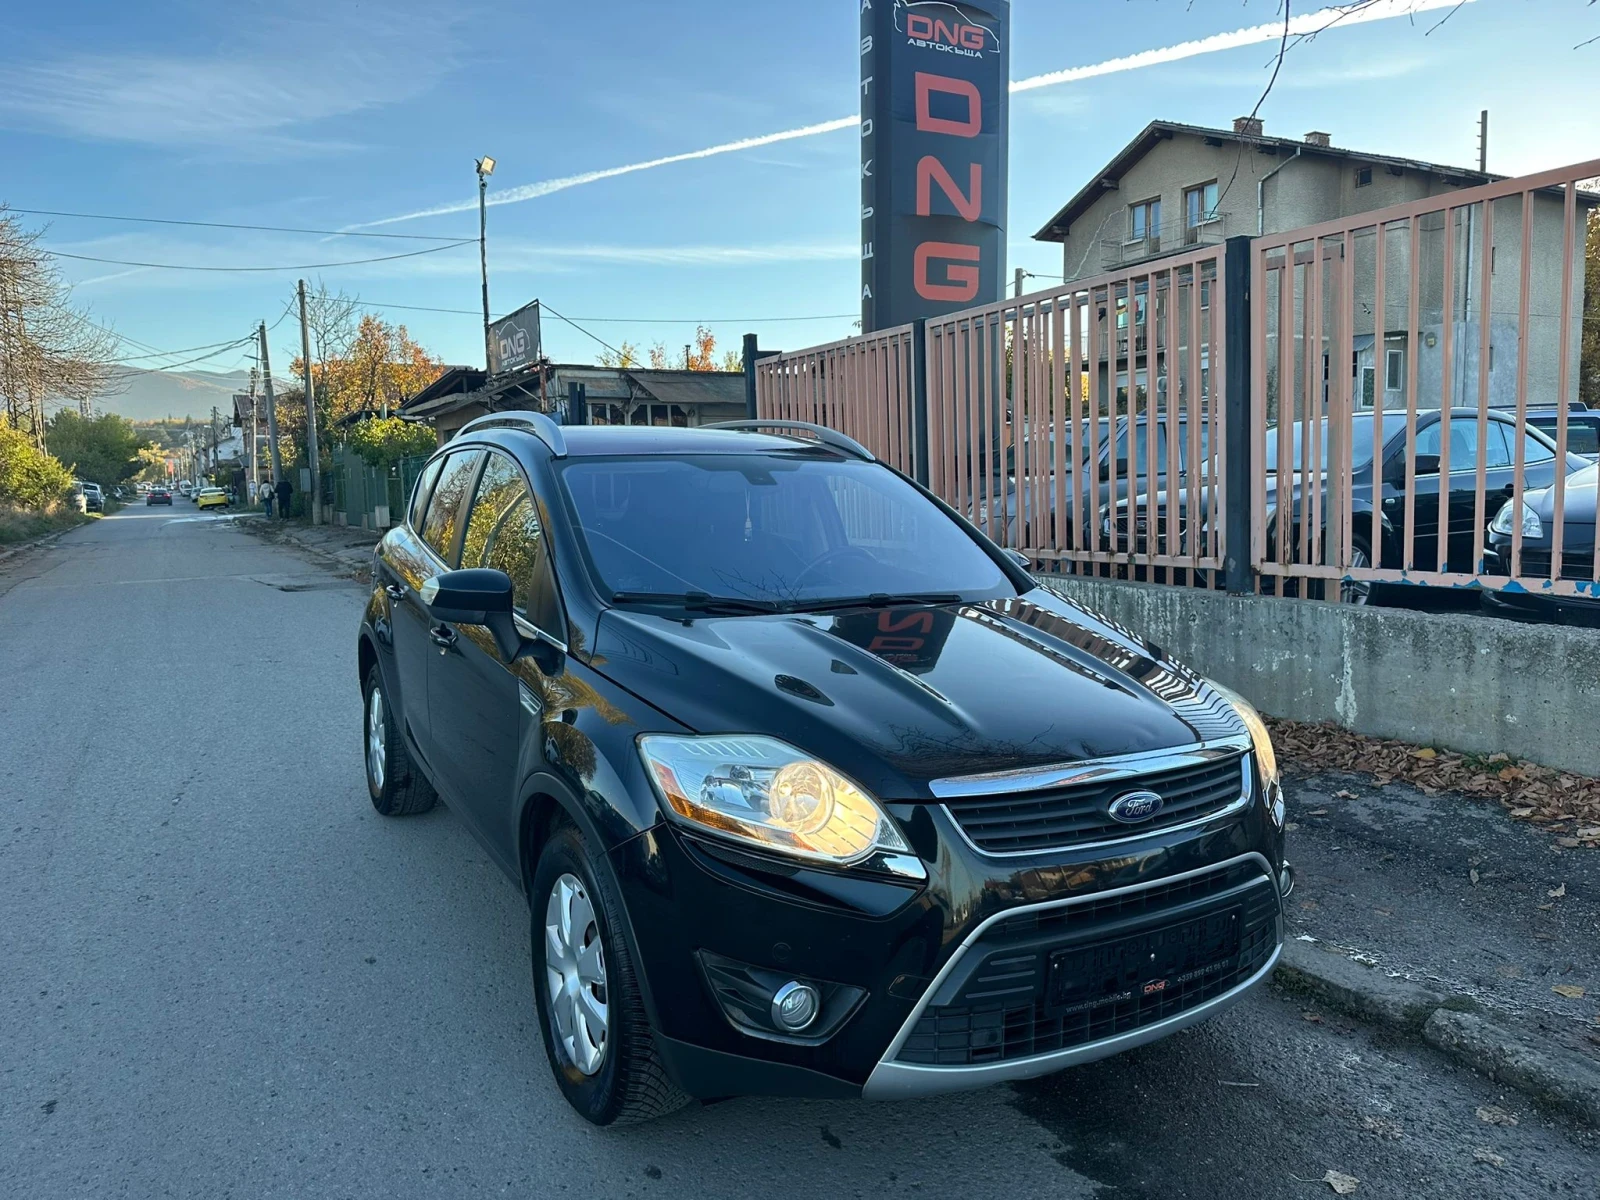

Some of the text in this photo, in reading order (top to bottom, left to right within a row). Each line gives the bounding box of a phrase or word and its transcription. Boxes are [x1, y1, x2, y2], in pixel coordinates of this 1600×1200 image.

[907, 13, 984, 50] DNG
[907, 38, 983, 59] АВТОКЪЩА
[914, 71, 982, 302] DNG
[500, 332, 525, 359] DNG
[1125, 798, 1153, 816] Ford
[1144, 980, 1166, 993] DNG
